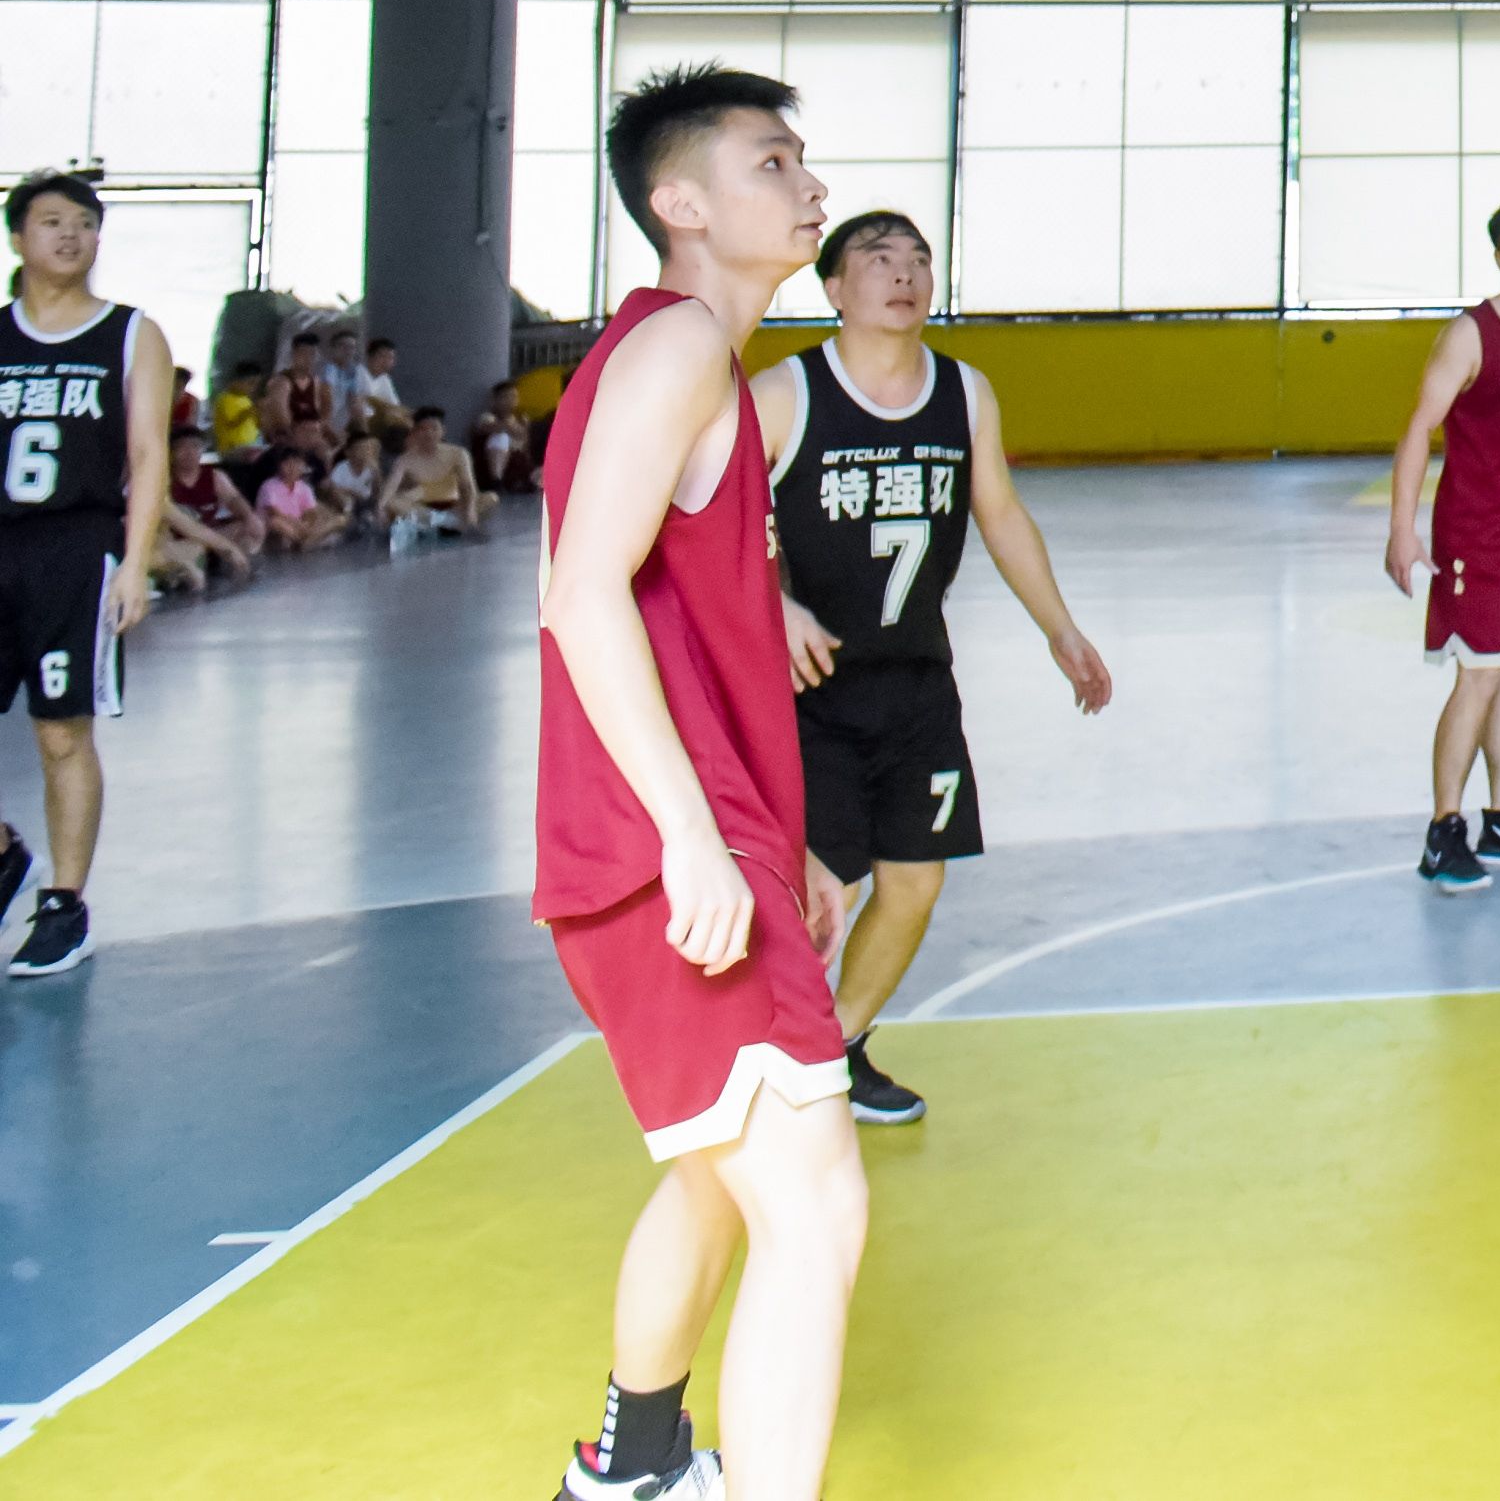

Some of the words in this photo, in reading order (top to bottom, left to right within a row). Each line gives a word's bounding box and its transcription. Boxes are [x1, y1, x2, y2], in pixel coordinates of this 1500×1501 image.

[5, 421, 62, 503] 6
[821, 466, 954, 522] 特强队
[870, 519, 931, 627] 7
[40, 649, 69, 700] 6
[930, 770, 960, 833] 7
